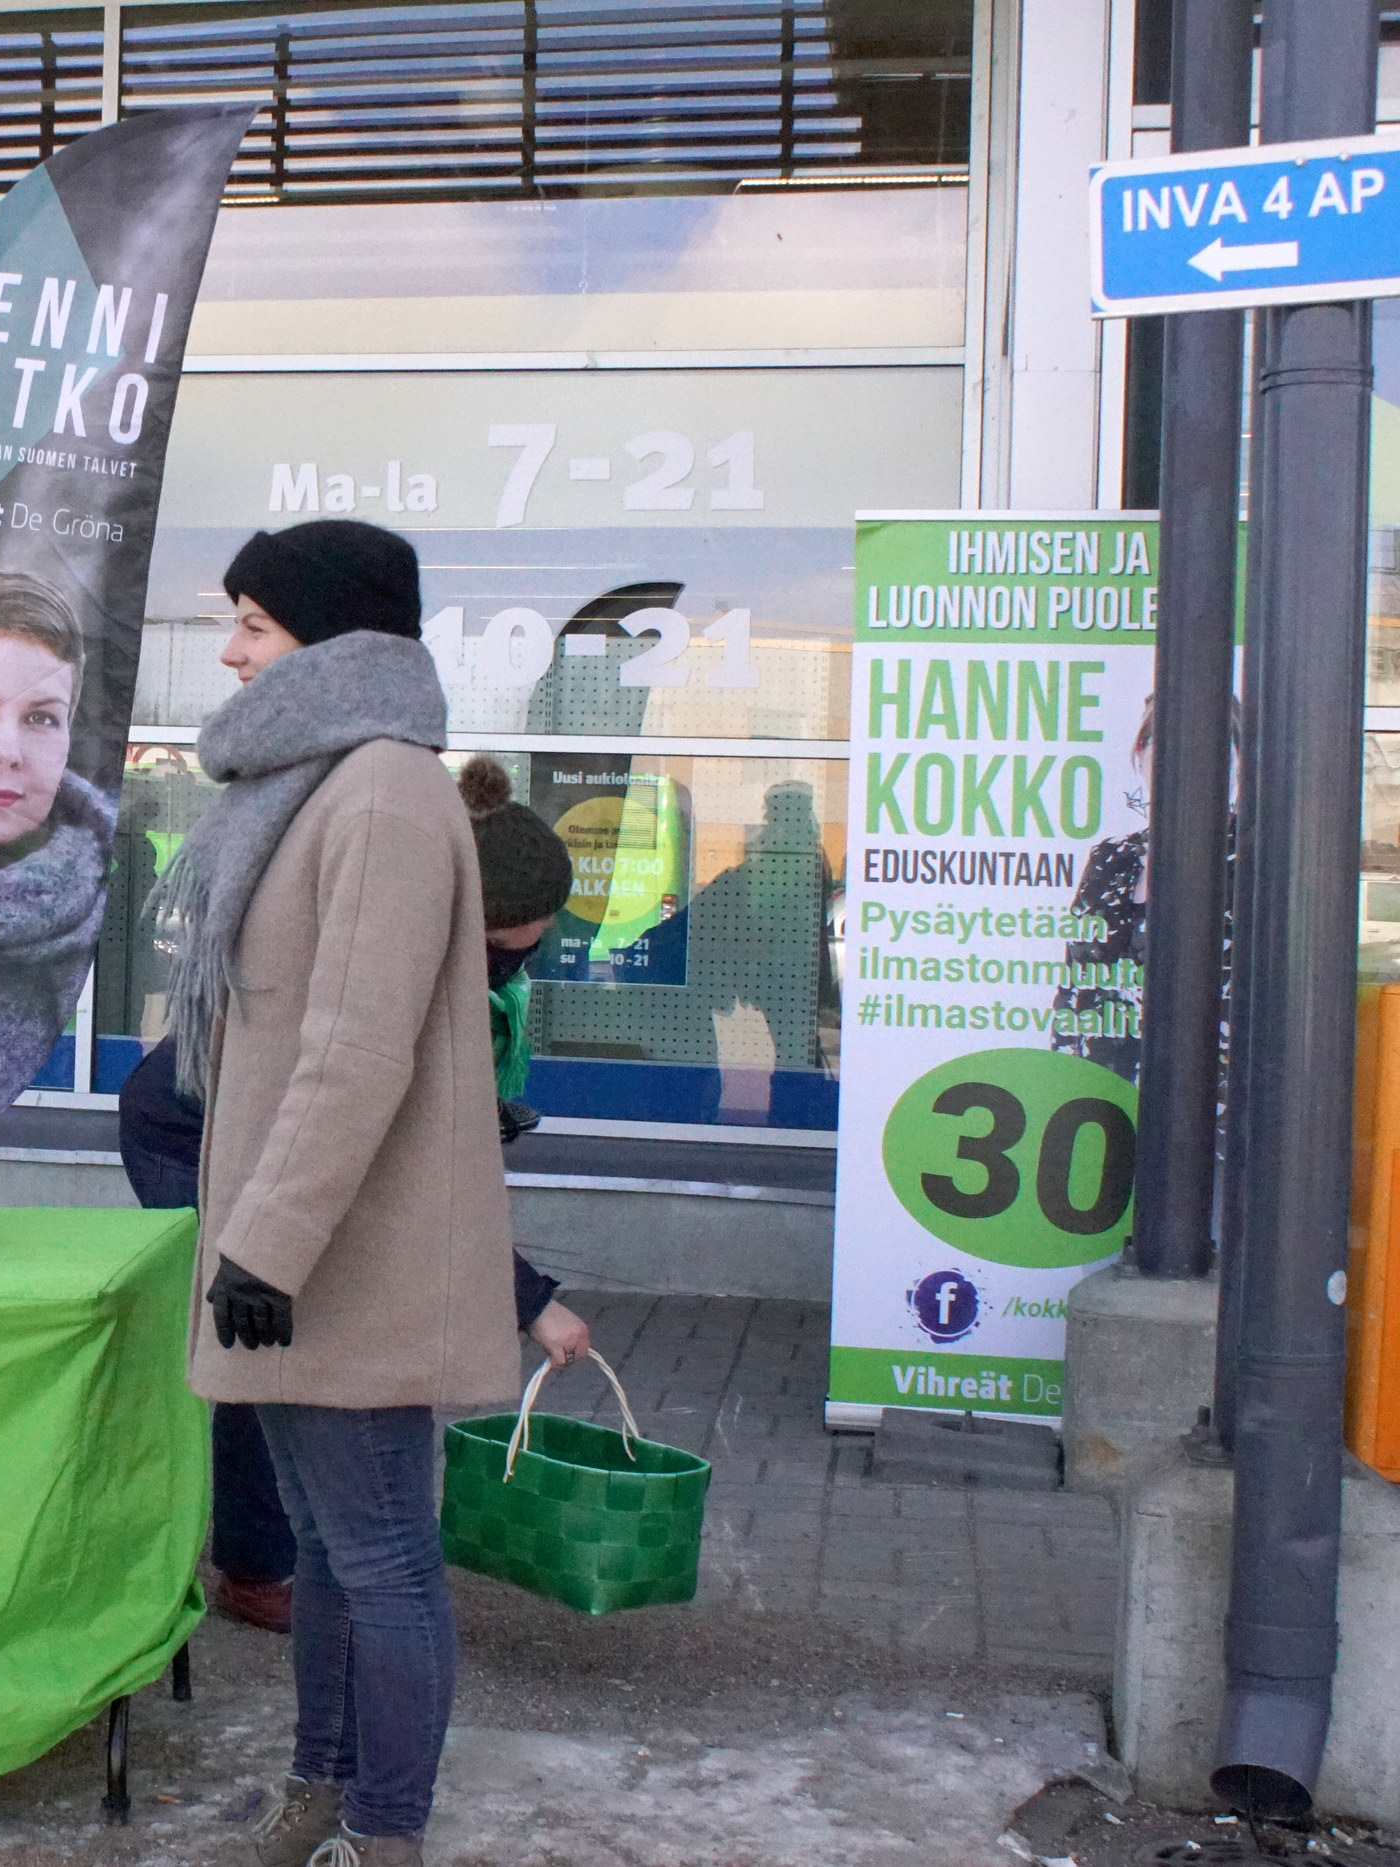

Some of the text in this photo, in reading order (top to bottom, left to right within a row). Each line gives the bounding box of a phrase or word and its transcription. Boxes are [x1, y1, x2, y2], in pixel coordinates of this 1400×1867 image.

[1122, 168, 1385, 232] INVA 4 AP
[18, 447, 77, 470] SUOMEN
[84, 456, 138, 478] TALVET
[269, 460, 439, 513] Ma-la
[11, 502, 42, 531] De
[53, 509, 124, 542] Gröna
[949, 530, 1150, 575] IHMISEN JA
[868, 585, 1158, 630] LUONNON PUOLE
[867, 658, 1105, 742] HANNE
[552, 771, 582, 784] Uusi
[864, 752, 1104, 839] KOKKO
[578, 856, 614, 873] KLO
[620, 858, 664, 876] 7:00
[863, 848, 1074, 888] EDUSKUNTAAN
[570, 878, 645, 897] ALKAEN
[860, 901, 1109, 942] Pysäytetään
[560, 954, 576, 963] su
[920, 1081, 1138, 1236] 30
[891, 1365, 1061, 1404] Vihreät De
